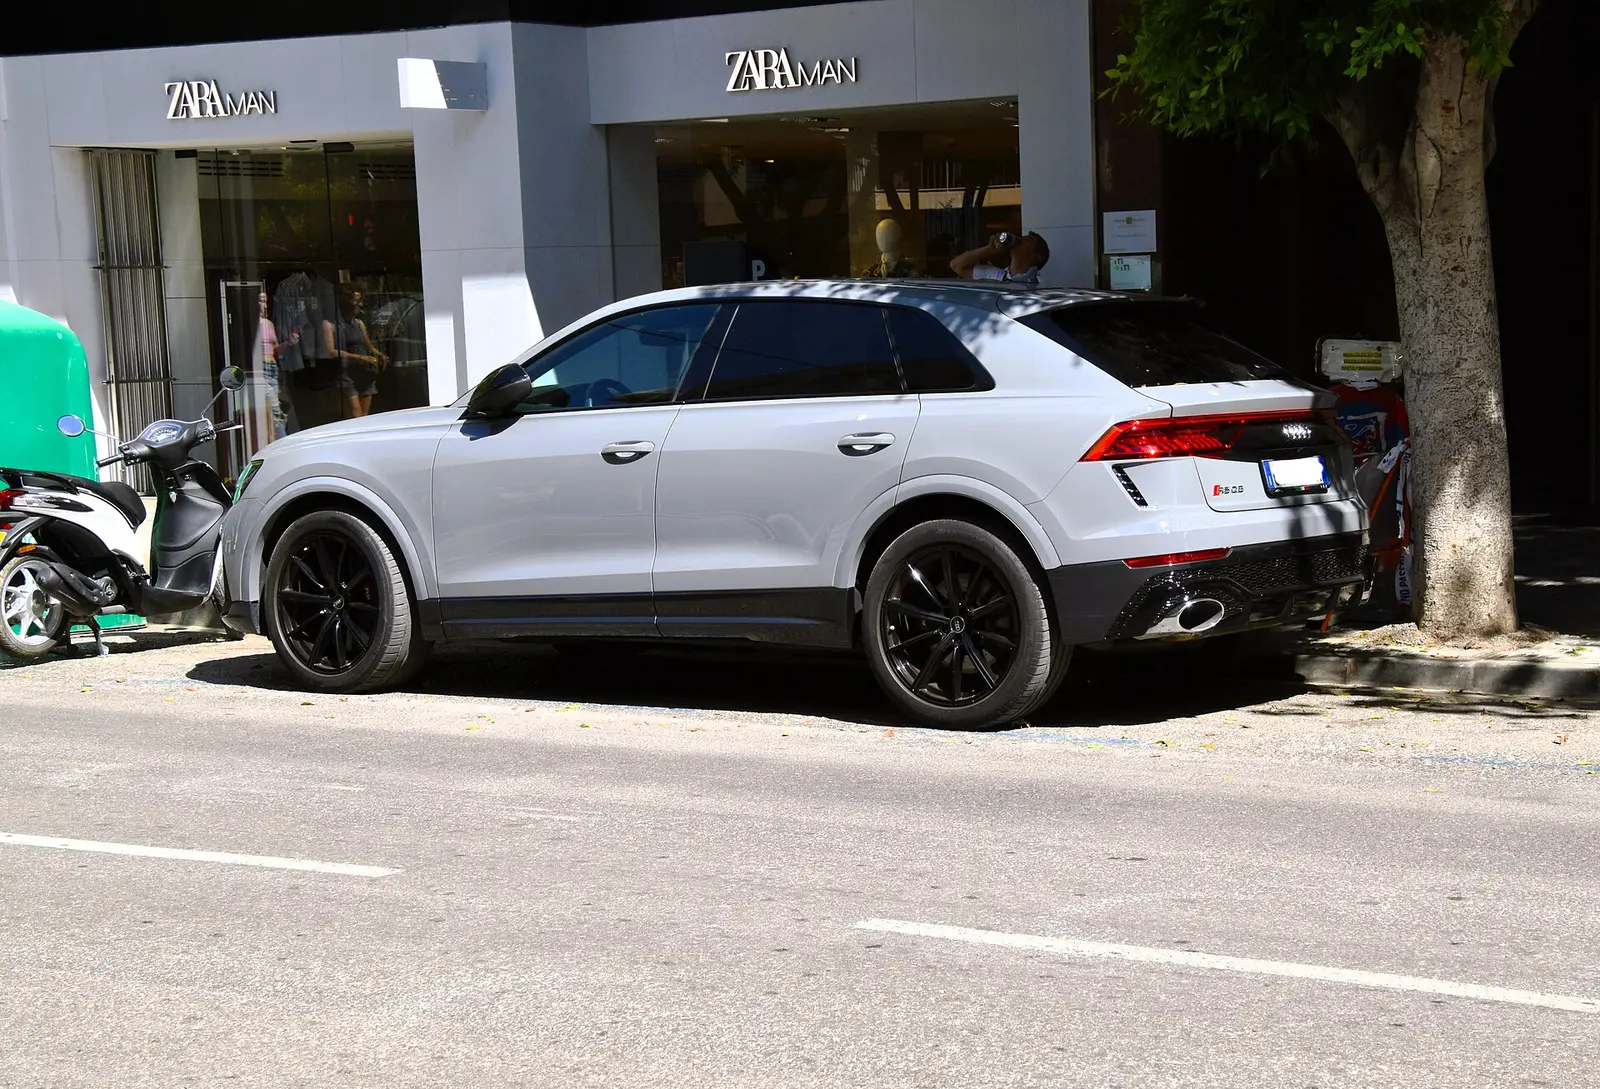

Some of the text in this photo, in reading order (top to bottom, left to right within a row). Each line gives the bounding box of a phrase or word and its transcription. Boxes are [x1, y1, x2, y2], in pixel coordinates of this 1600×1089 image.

[725, 47, 857, 92] ZARA MAN
[164, 80, 276, 119] ZARA MAN
